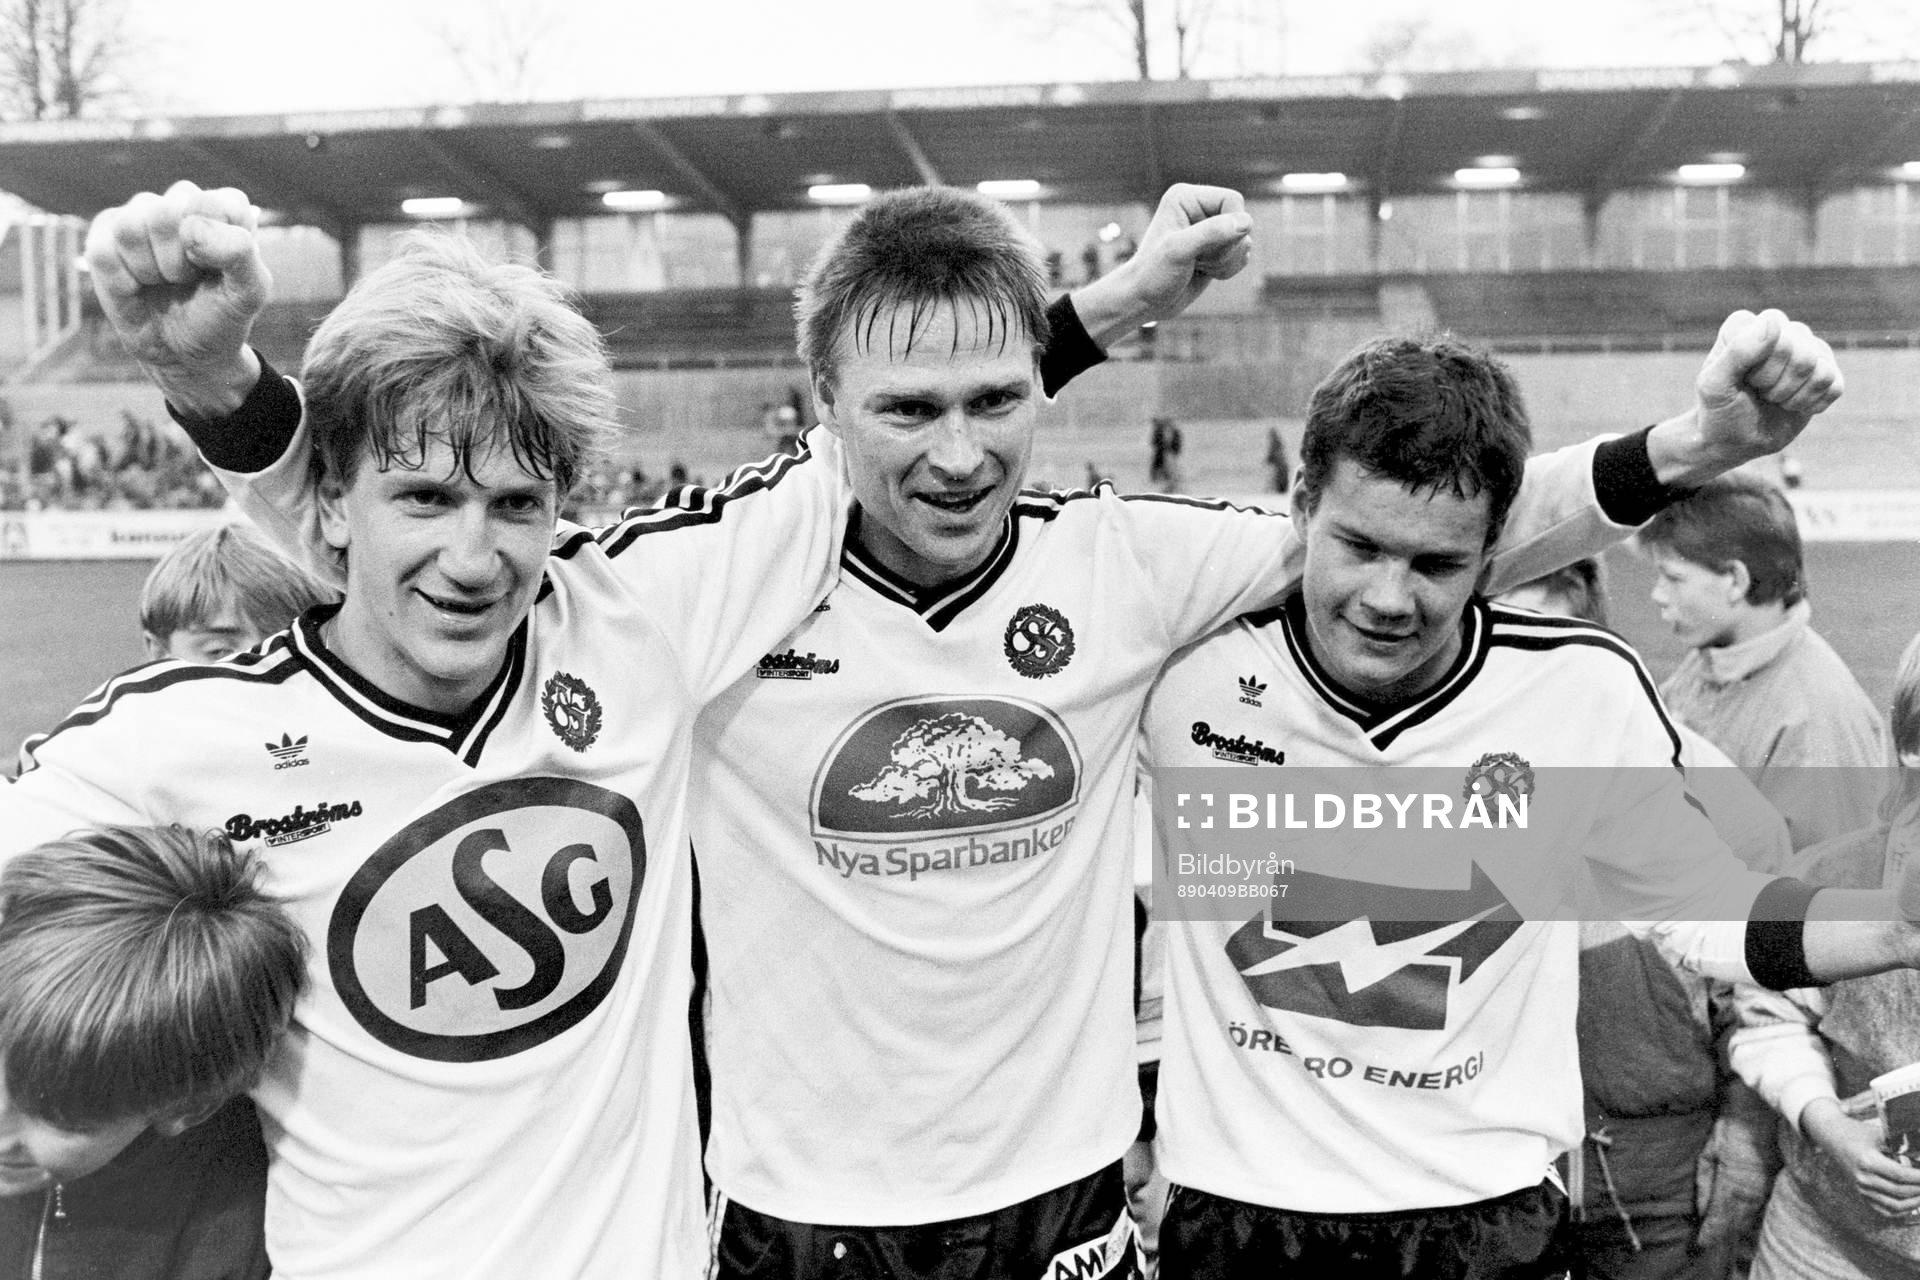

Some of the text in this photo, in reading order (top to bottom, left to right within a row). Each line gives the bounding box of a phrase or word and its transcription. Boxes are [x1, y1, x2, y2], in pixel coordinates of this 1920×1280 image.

[274, 757, 310, 770] adidas
[1191, 721, 1285, 766] Broströms
[225, 800, 363, 841] Broströms
[814, 840, 880, 878] Nya
[410, 828, 613, 1011] ASG
[1228, 1021, 1484, 1090] ÖRERO ENERGI
